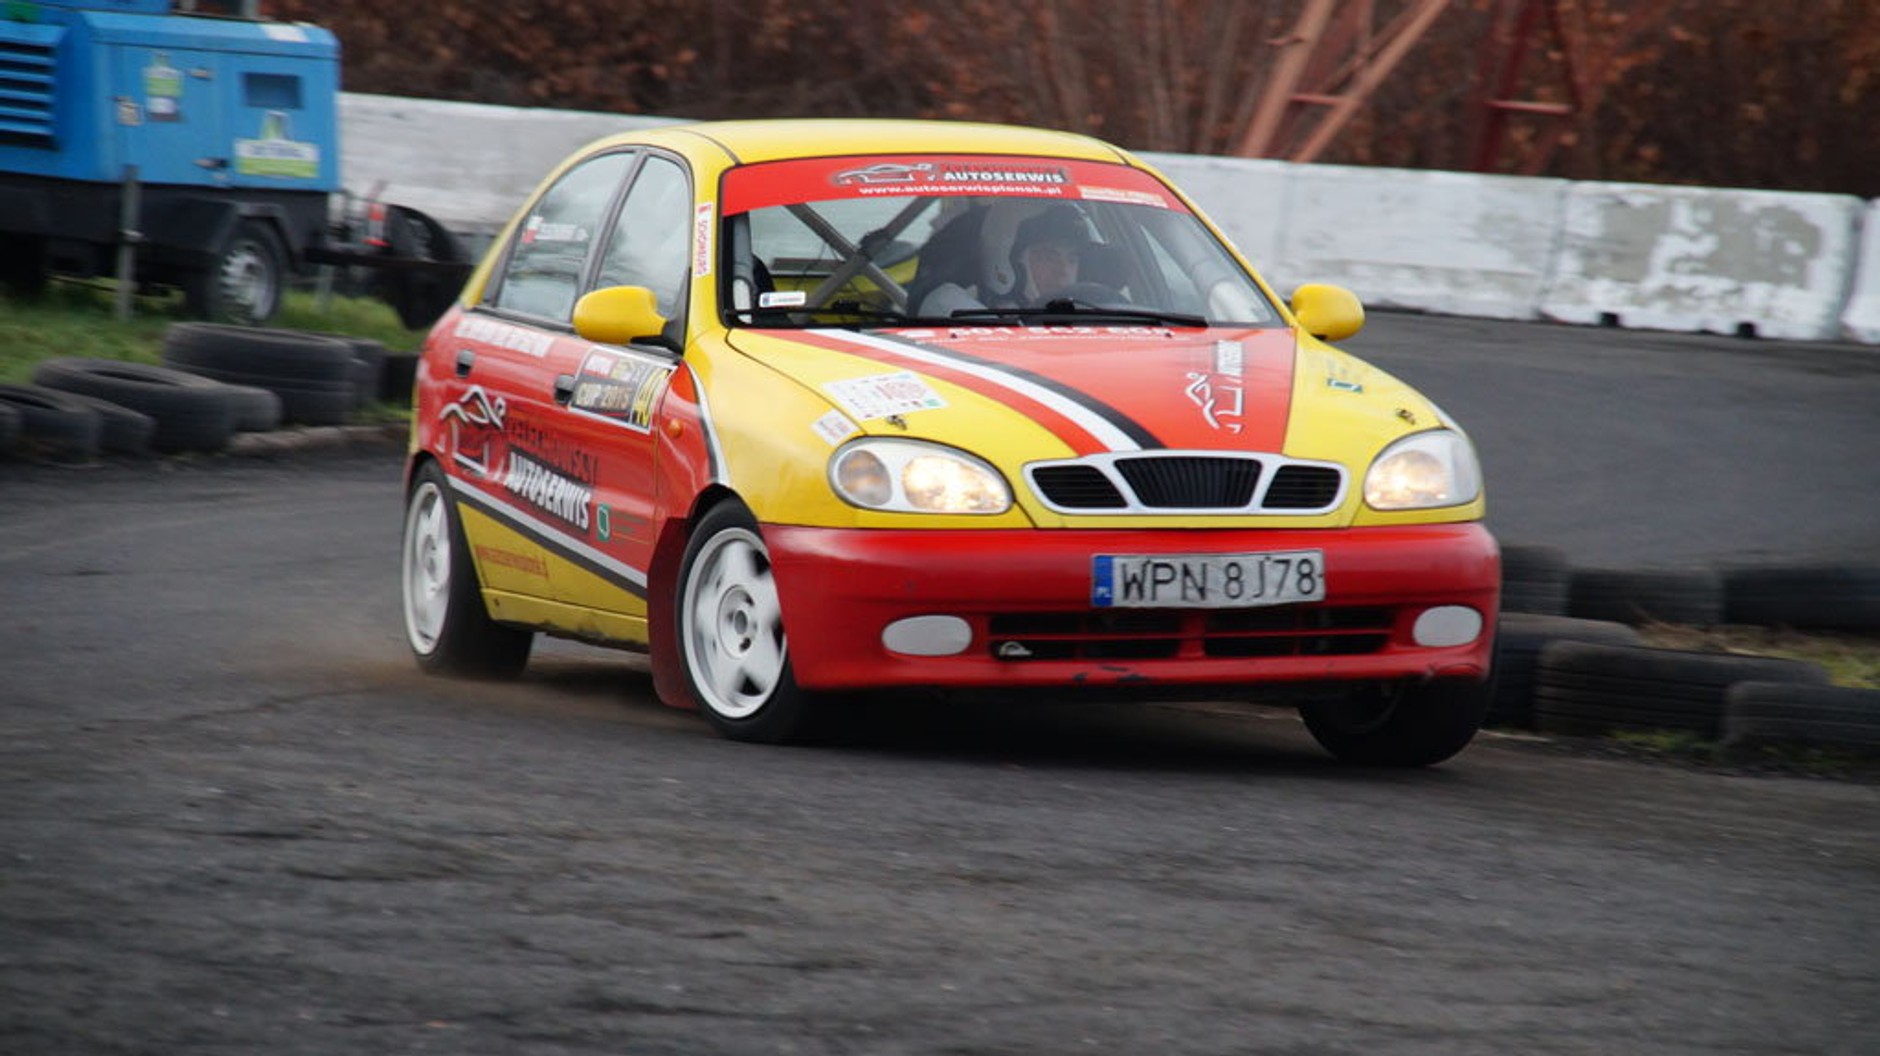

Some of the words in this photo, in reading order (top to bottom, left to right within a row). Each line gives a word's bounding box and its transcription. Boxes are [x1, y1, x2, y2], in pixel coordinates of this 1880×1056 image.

[943, 171, 1064, 183] AUTOSERWIS
[504, 452, 591, 530] AUTOSERWIS
[1121, 561, 1208, 600] WPN
[1224, 558, 1316, 600] 8J78
